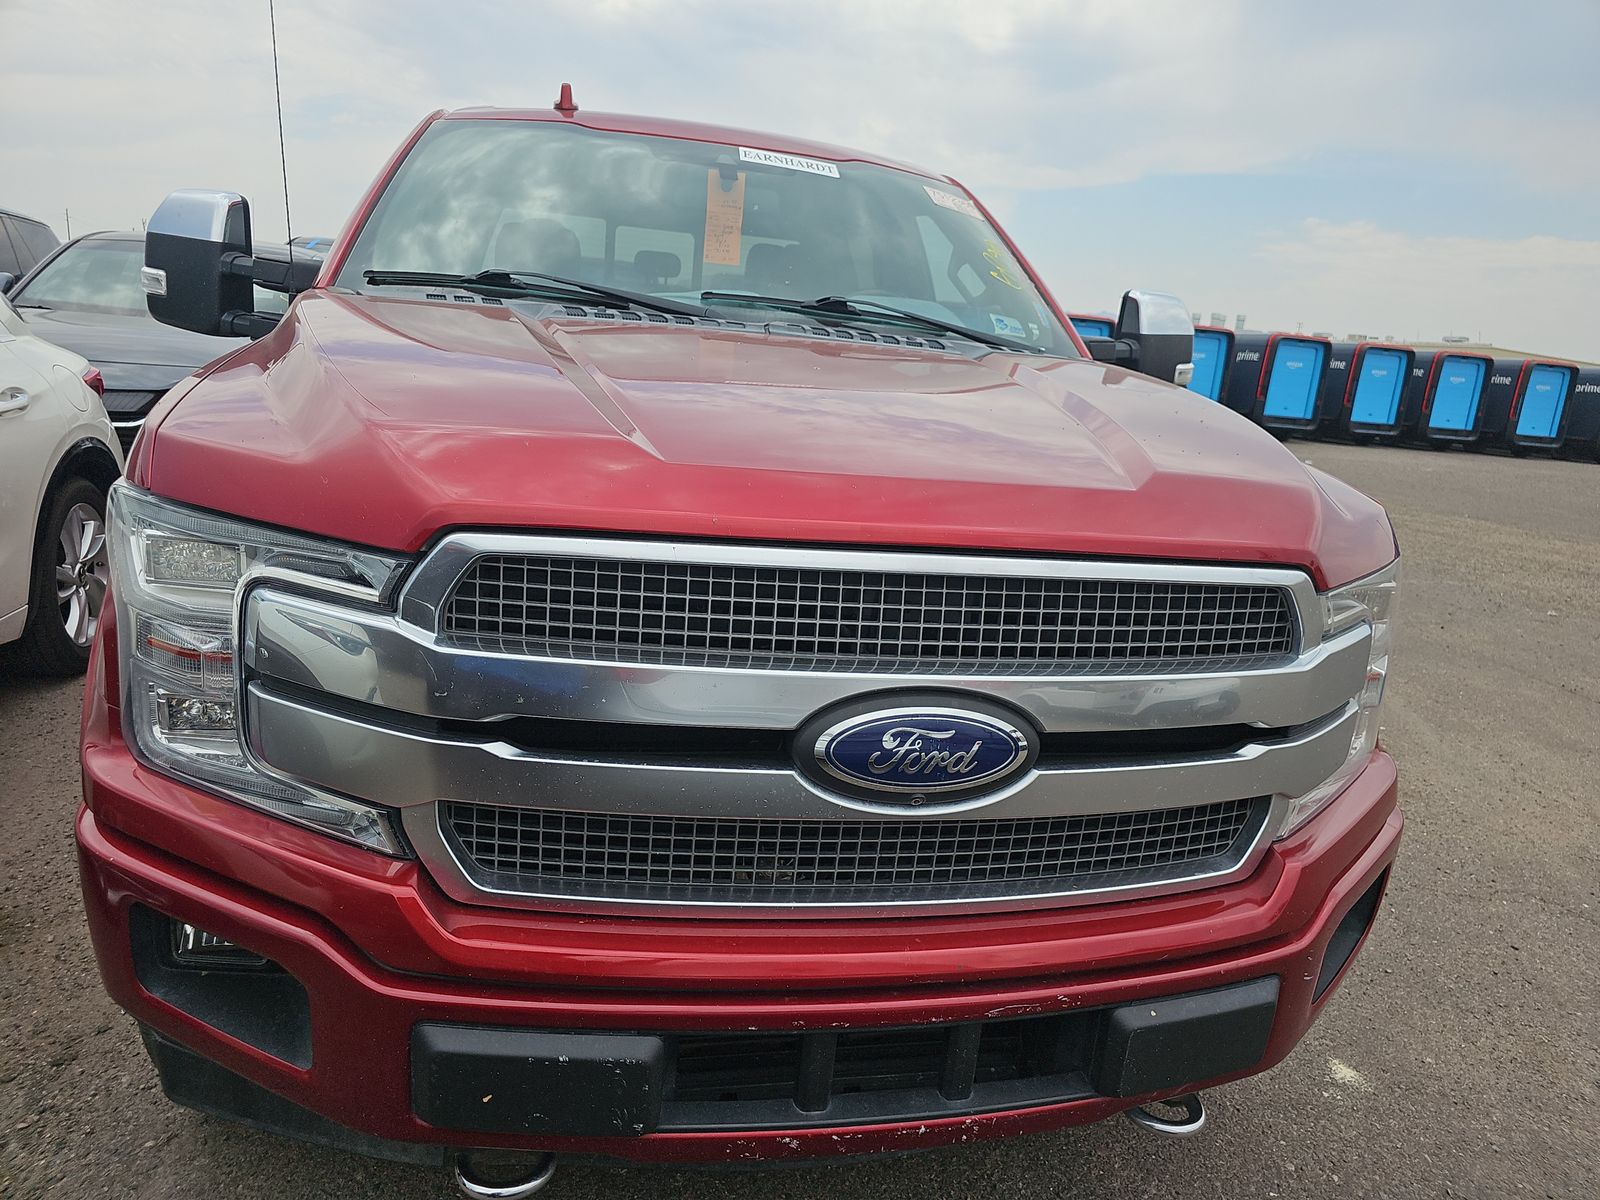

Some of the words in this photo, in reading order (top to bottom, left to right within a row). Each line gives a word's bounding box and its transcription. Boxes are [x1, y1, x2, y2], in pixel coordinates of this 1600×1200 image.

[742, 150, 835, 175] EARNHARDT
[1236, 349, 1260, 362] prime
[1329, 358, 1346, 370] ime
[1490, 374, 1512, 385] rime
[867, 727, 981, 775] Ford
